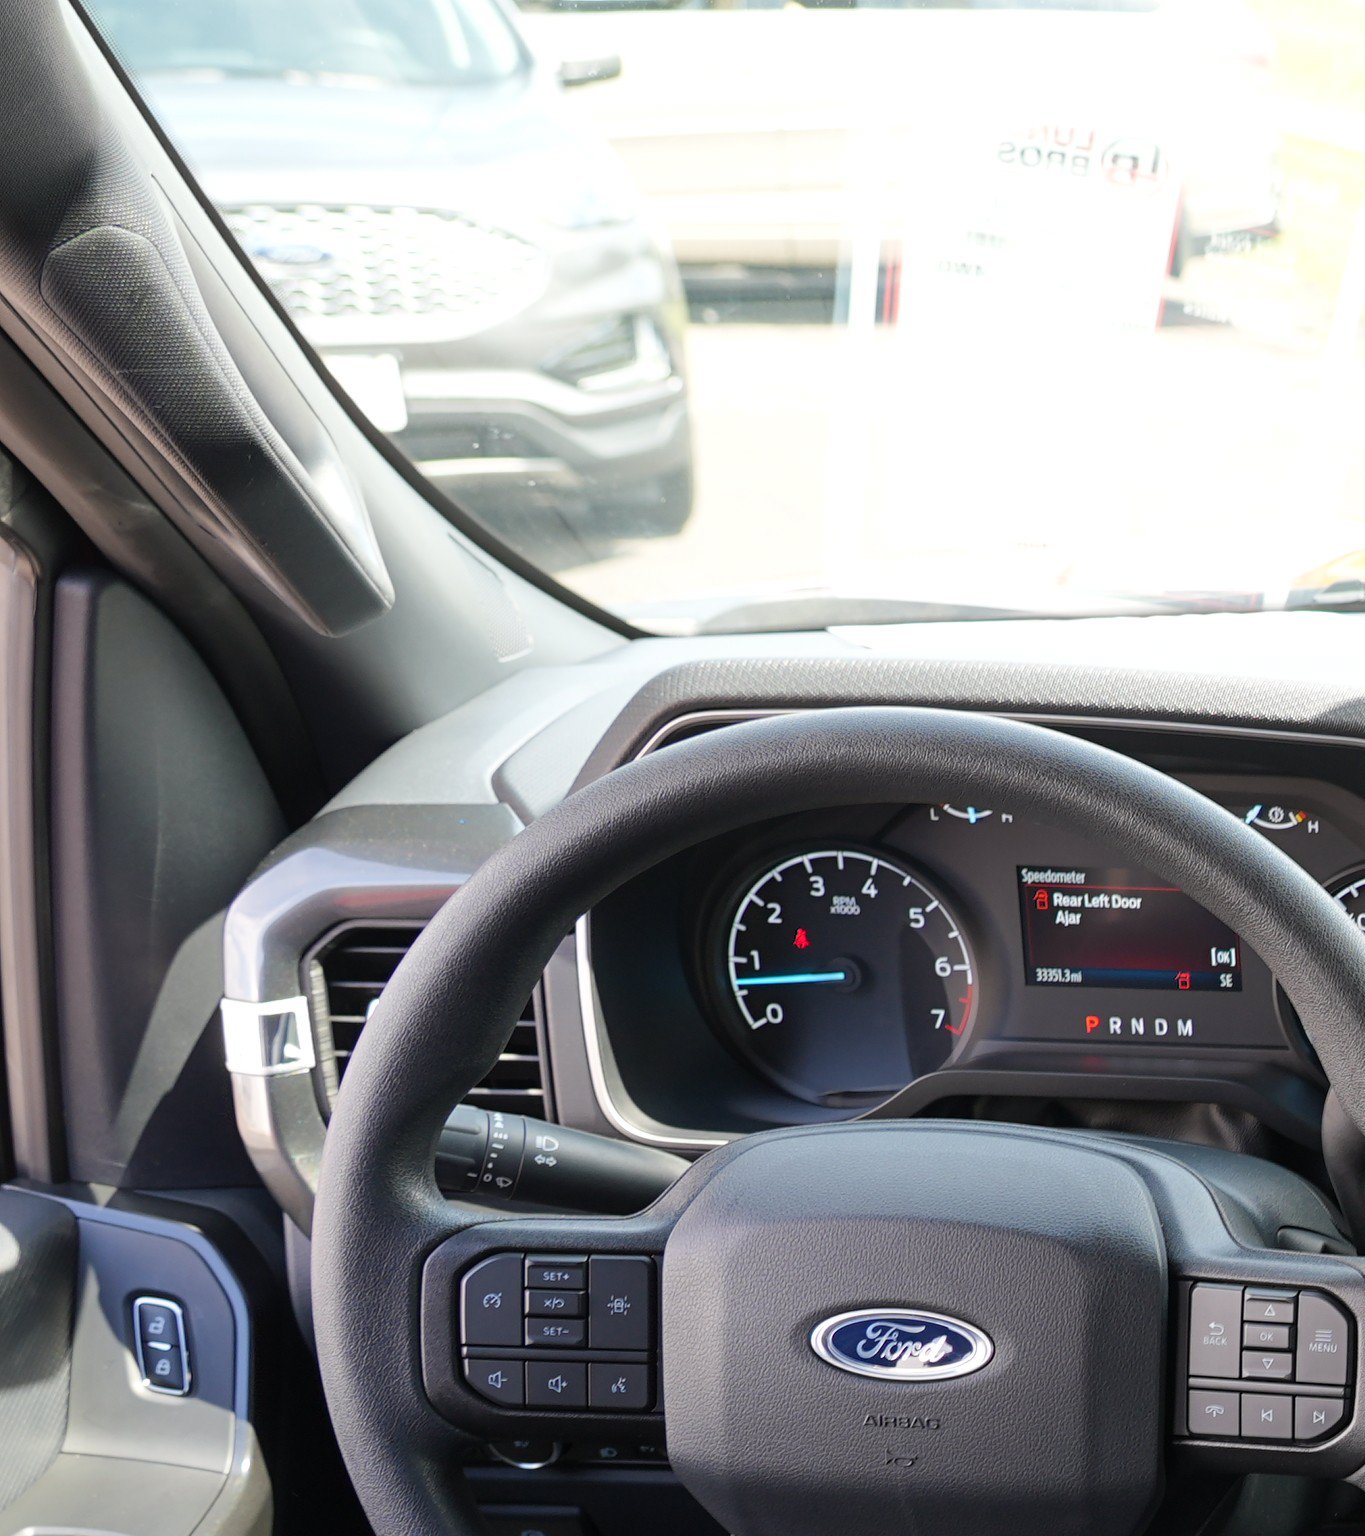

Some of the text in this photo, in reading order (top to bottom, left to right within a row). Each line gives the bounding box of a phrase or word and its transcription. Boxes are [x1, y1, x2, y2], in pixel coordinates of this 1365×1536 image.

[1307, 820, 1319, 834] H
[1021, 869, 1086, 885] Speedometer
[809, 875, 826, 898] 3
[861, 878, 879, 899] 4
[832, 895, 857, 907] RPM
[1053, 892, 1142, 910] Rear Left Door
[766, 903, 783, 925] 2
[908, 908, 926, 929] 5
[1055, 910, 1082, 927] Ajar
[750, 951, 761, 970] 1
[934, 958, 952, 978] 6
[1219, 973, 1234, 988] SE
[766, 1004, 783, 1024] 0
[930, 1009, 946, 1029] 7
[1085, 1015, 1194, 1037] P R N D M
[856, 1321, 949, 1363] Ford
[1202, 1336, 1228, 1346] BACK
[1259, 1331, 1274, 1342] OK
[1308, 1342, 1338, 1354] MENU
[862, 1413, 942, 1431] AIRBAG
